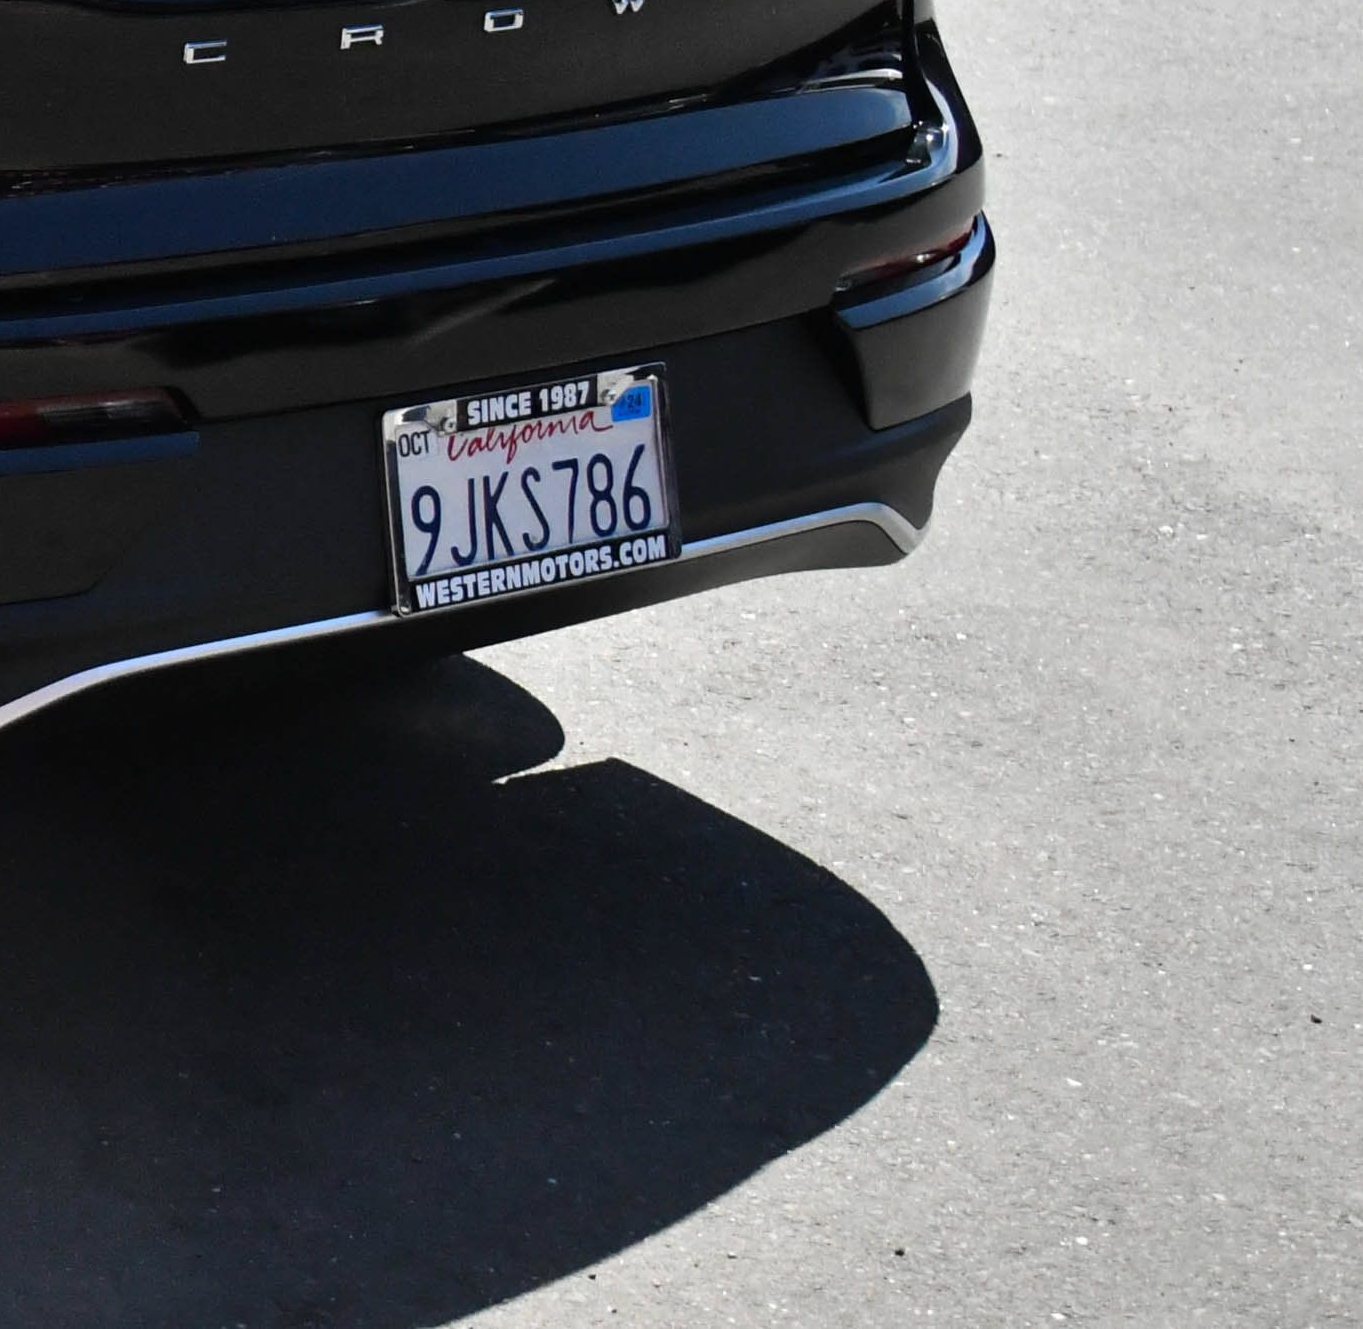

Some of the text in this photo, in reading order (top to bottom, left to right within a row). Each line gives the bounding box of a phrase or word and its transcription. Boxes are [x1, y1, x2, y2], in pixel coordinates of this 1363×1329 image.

[467, 381, 591, 426] SINCE 1987
[399, 430, 431, 458] OCT
[446, 410, 613, 465] California
[411, 444, 652, 576] 9JKS786
[416, 534, 667, 609] WESTERNMOTORS.COM
